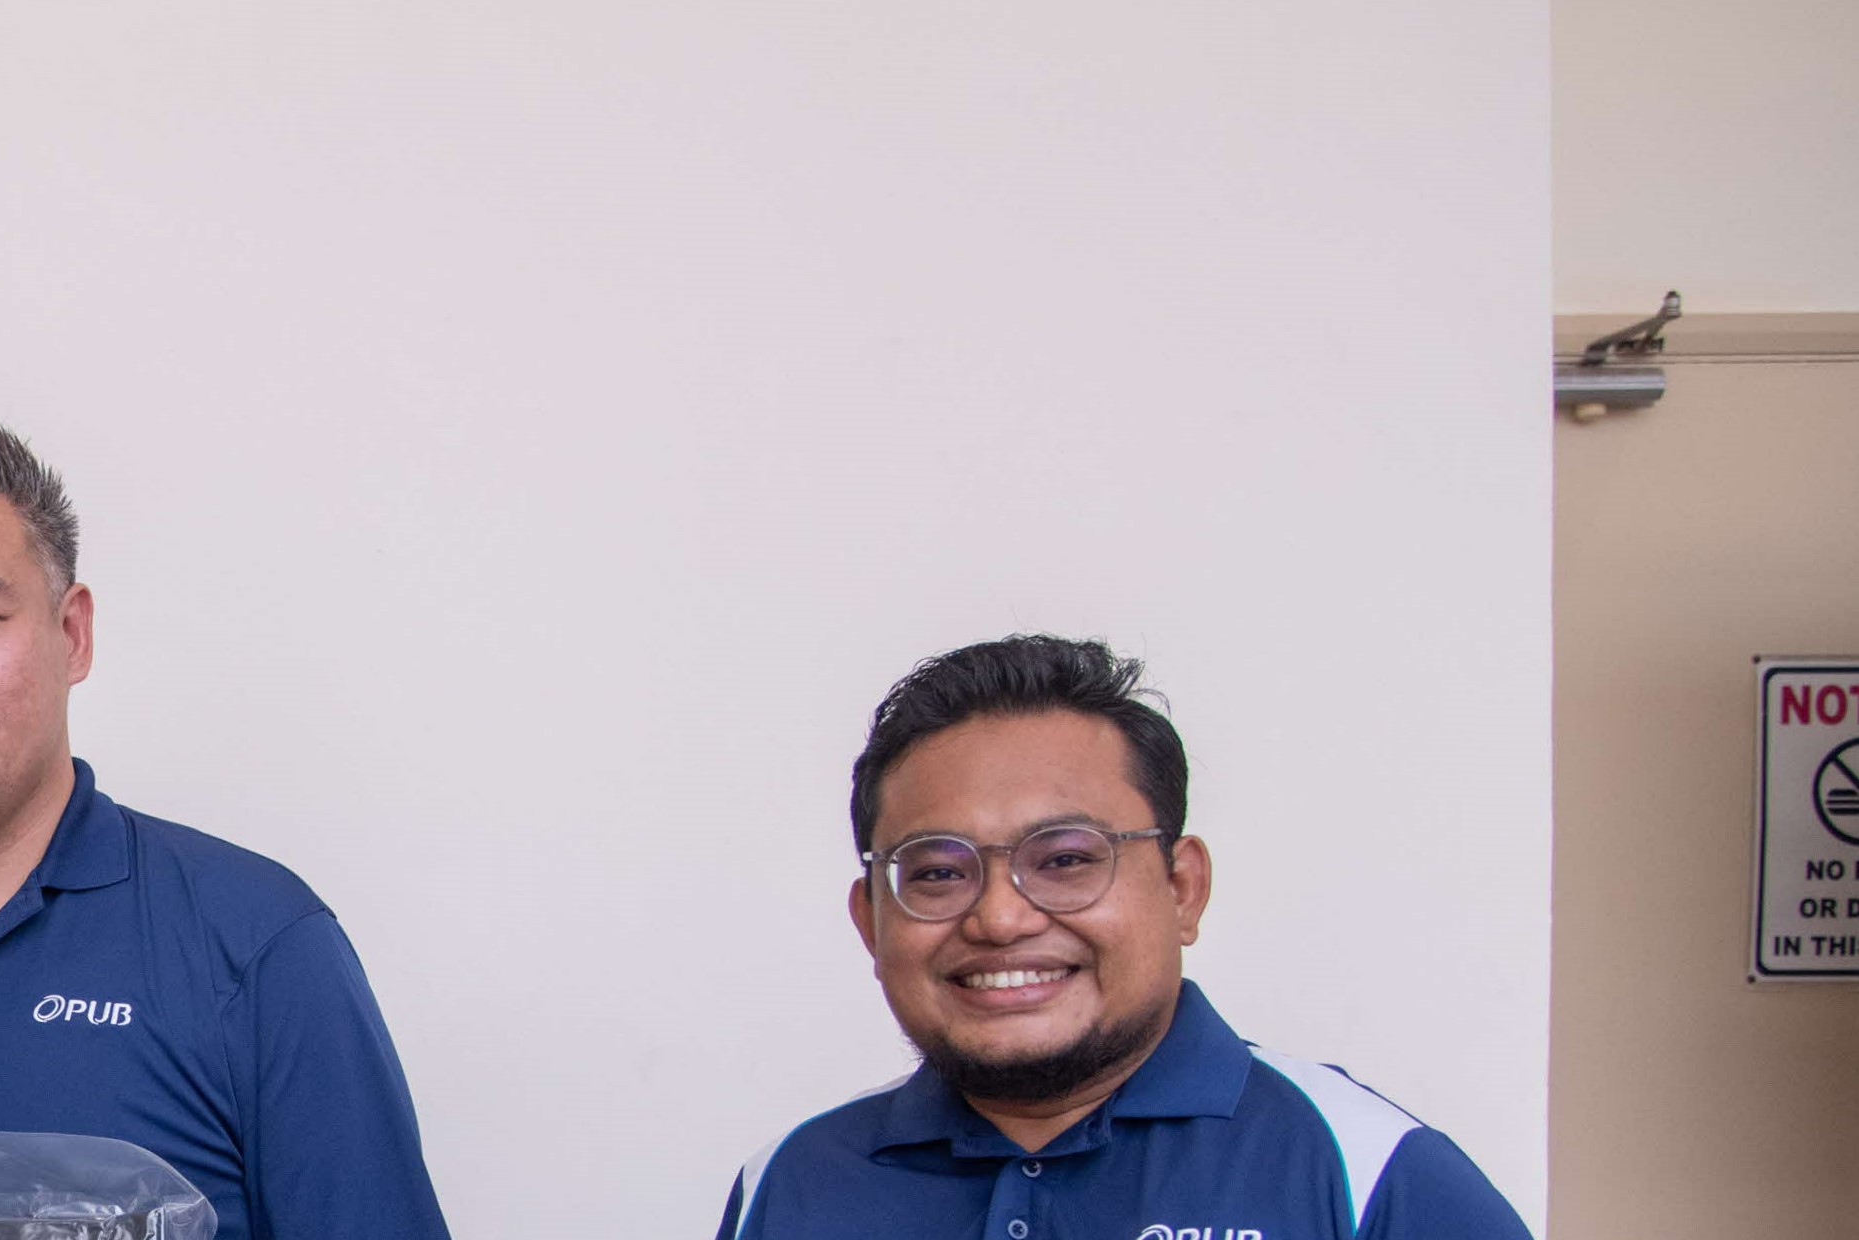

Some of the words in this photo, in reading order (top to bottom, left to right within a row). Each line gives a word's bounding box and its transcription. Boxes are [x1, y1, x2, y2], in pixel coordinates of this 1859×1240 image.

[1806, 861, 1845, 881] NO
[1800, 899, 1837, 919] OR
[1773, 936, 1801, 956] IN
[1811, 936, 1859, 956] THI
